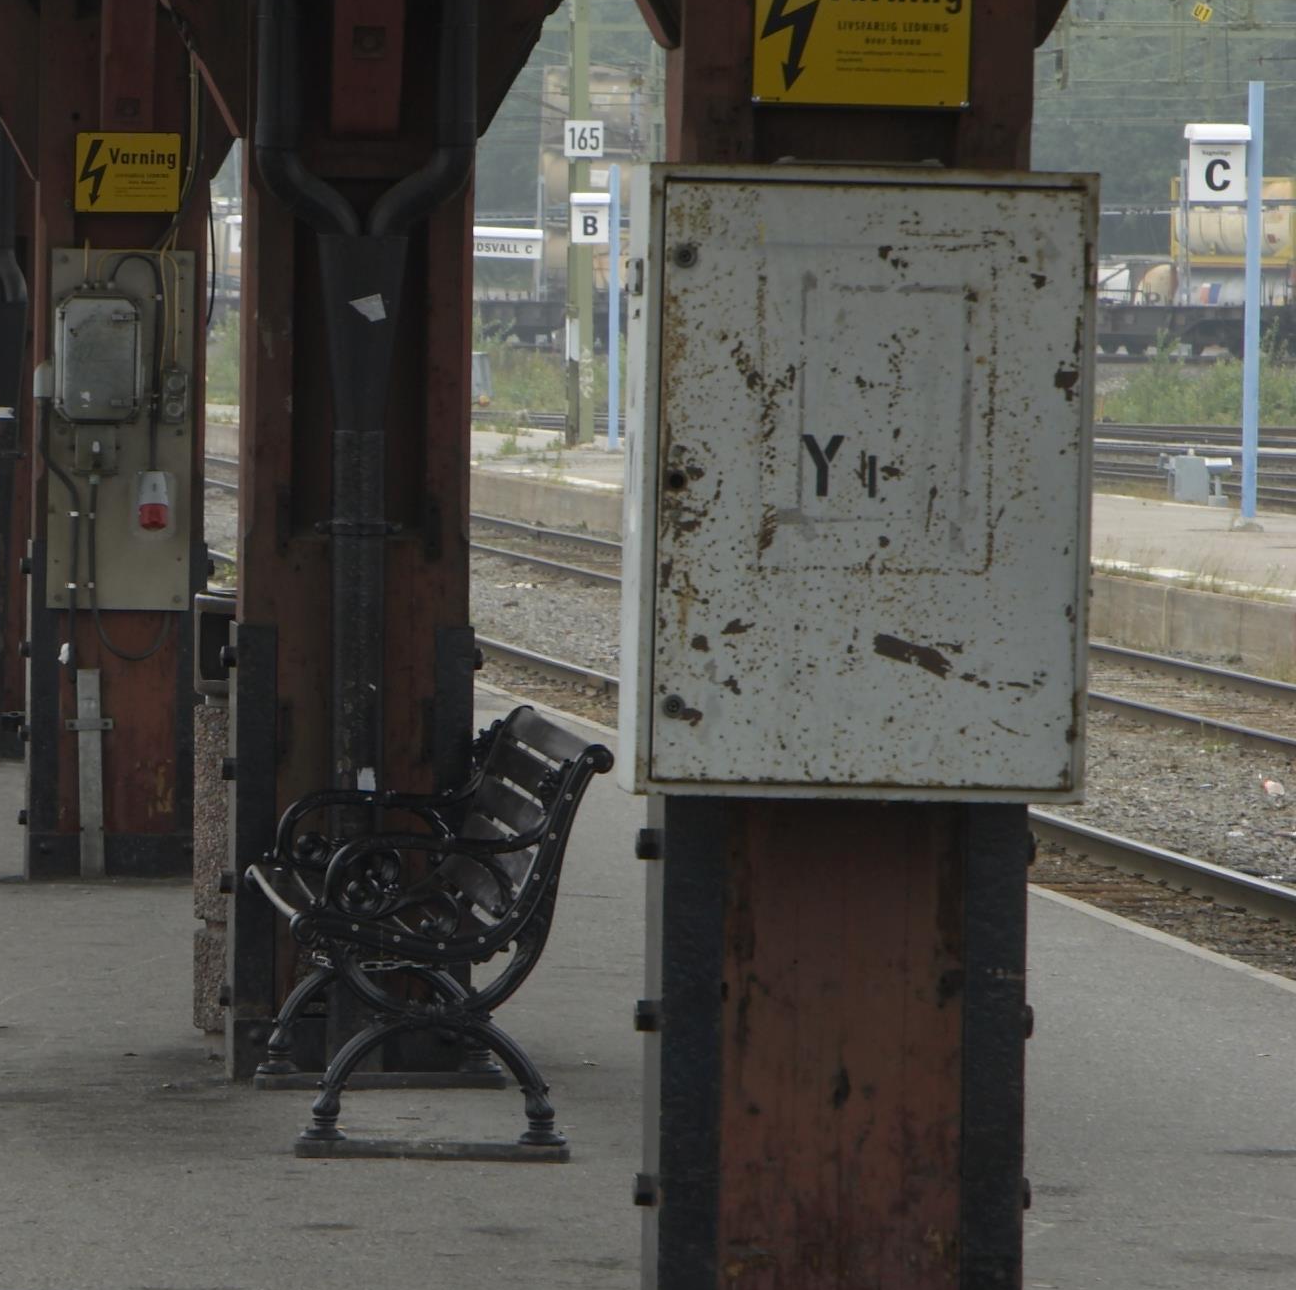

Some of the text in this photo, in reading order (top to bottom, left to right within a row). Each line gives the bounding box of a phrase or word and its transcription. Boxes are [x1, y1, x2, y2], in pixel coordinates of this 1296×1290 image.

[903, 23, 950, 34] LEDNING
[569, 127, 600, 151] 165
[109, 148, 177, 170] Varning
[1205, 159, 1231, 192] C
[583, 215, 598, 236] B
[525, 245, 533, 254] C
